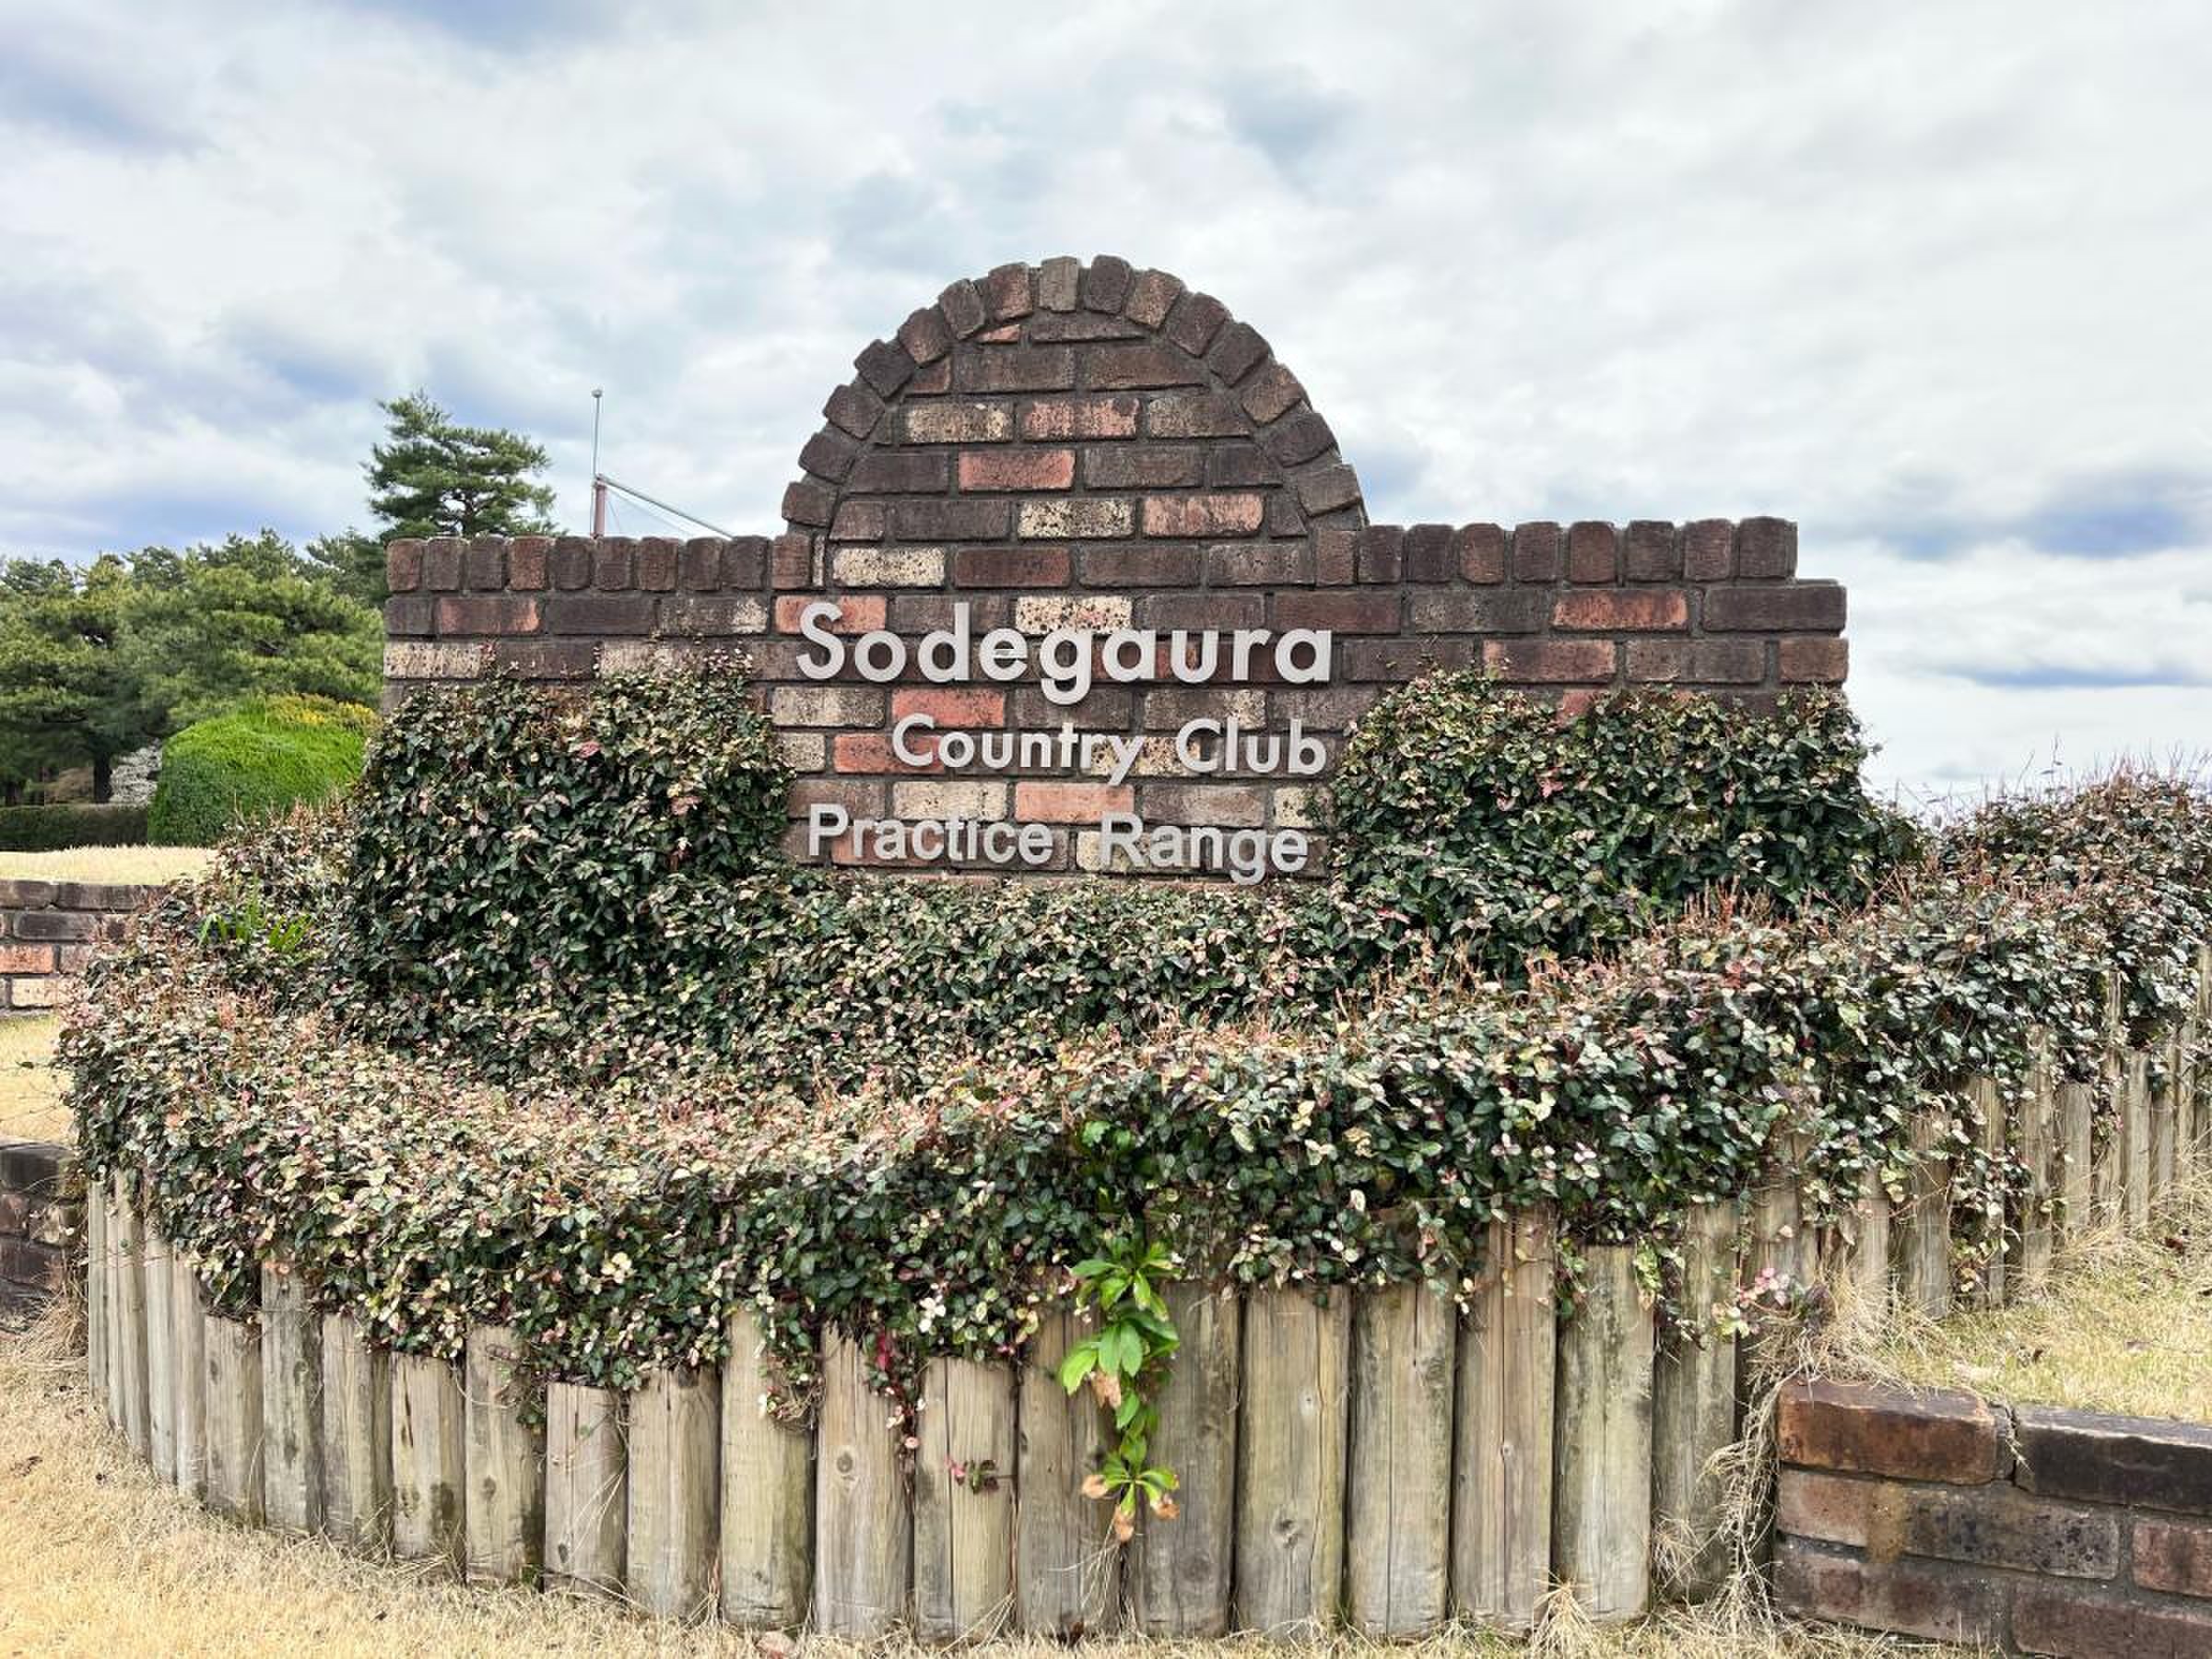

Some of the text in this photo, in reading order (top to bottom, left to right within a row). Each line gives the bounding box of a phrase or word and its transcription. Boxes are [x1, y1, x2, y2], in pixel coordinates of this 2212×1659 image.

[795, 602, 1333, 705] Sodegaura
[891, 712, 1327, 786] Country Club
[808, 803, 1309, 886] Practice Range
